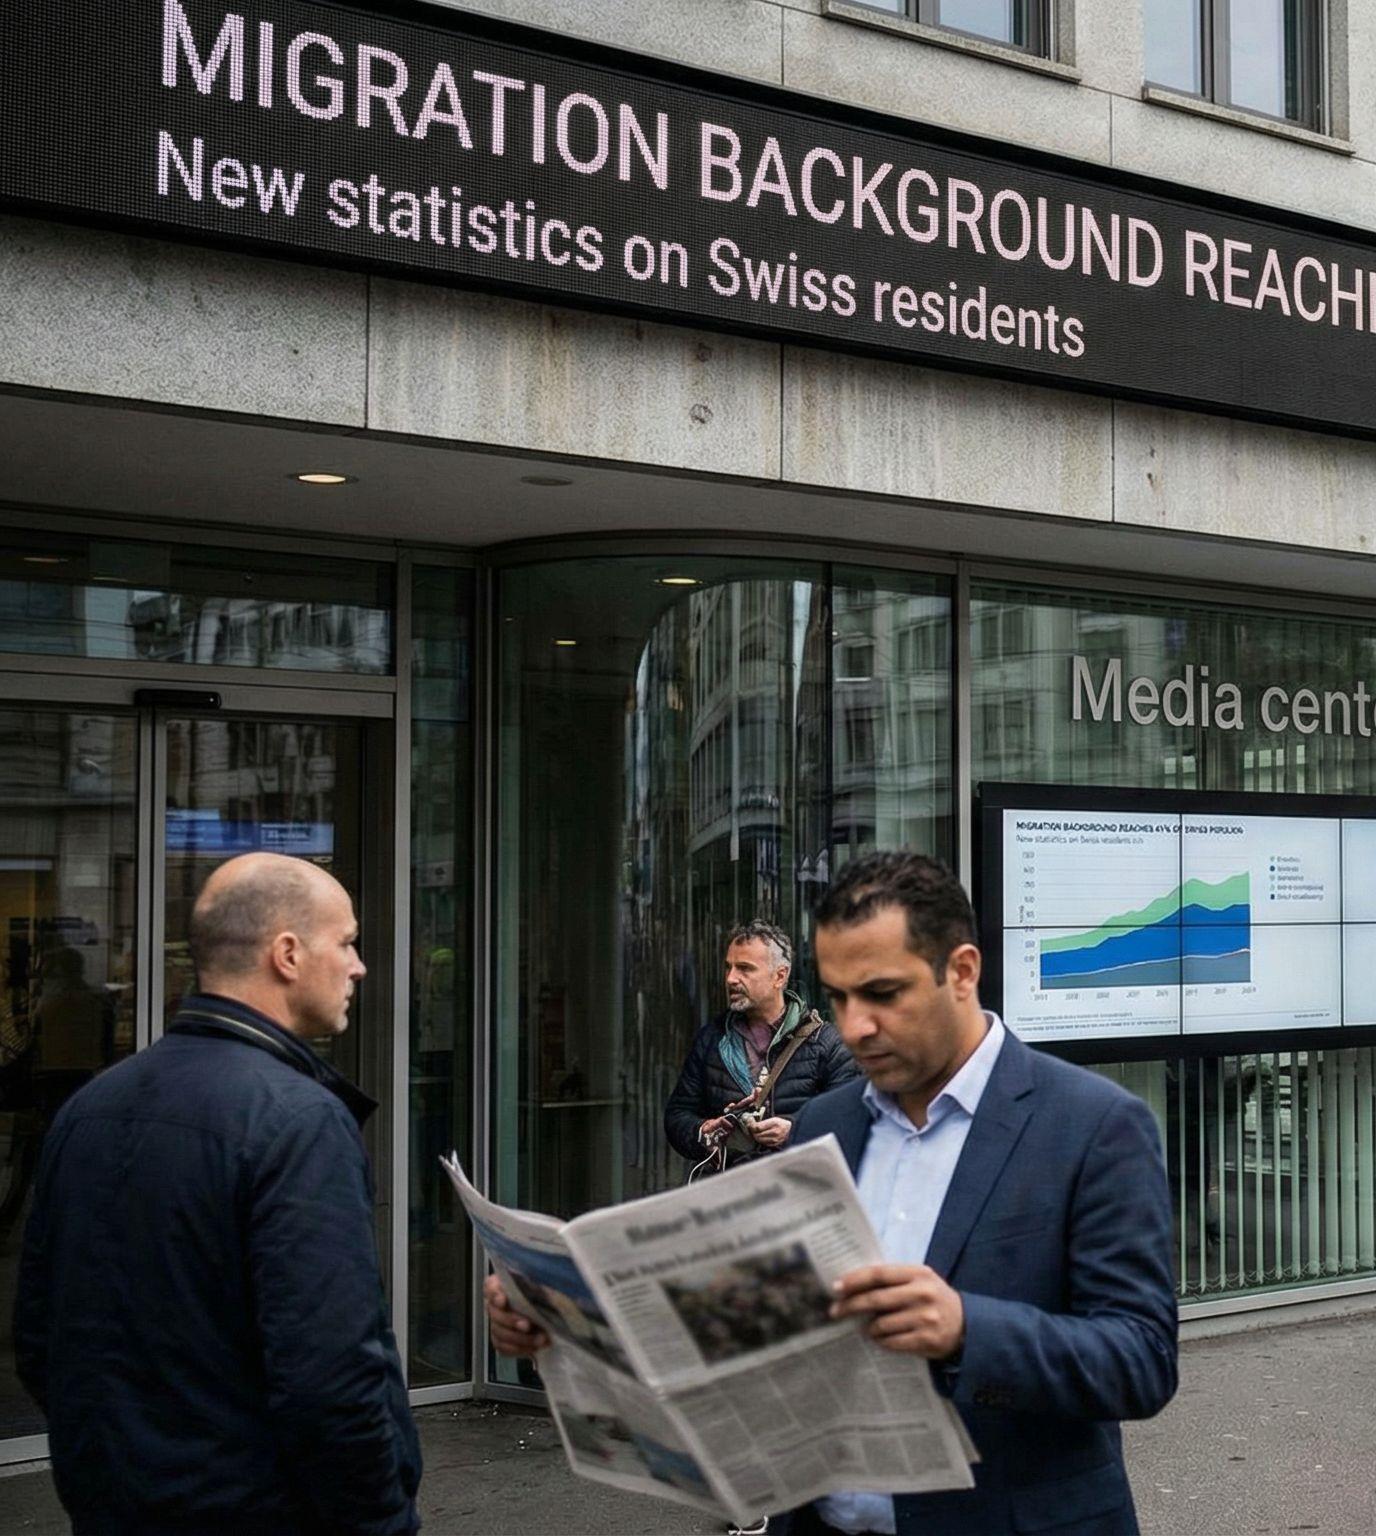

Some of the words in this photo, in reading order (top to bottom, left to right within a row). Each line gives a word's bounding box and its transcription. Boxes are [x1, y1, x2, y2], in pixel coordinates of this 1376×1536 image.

[157, 130, 305, 216] New
[326, 173, 604, 272] statistics
[623, 234, 689, 288] on
[708, 237, 857, 317] Swiss
[874, 281, 1086, 358] residents
[161, 0, 669, 191] MIGRATION
[700, 121, 1163, 288] BACKGROUND
[1071, 655, 1245, 731] Media
